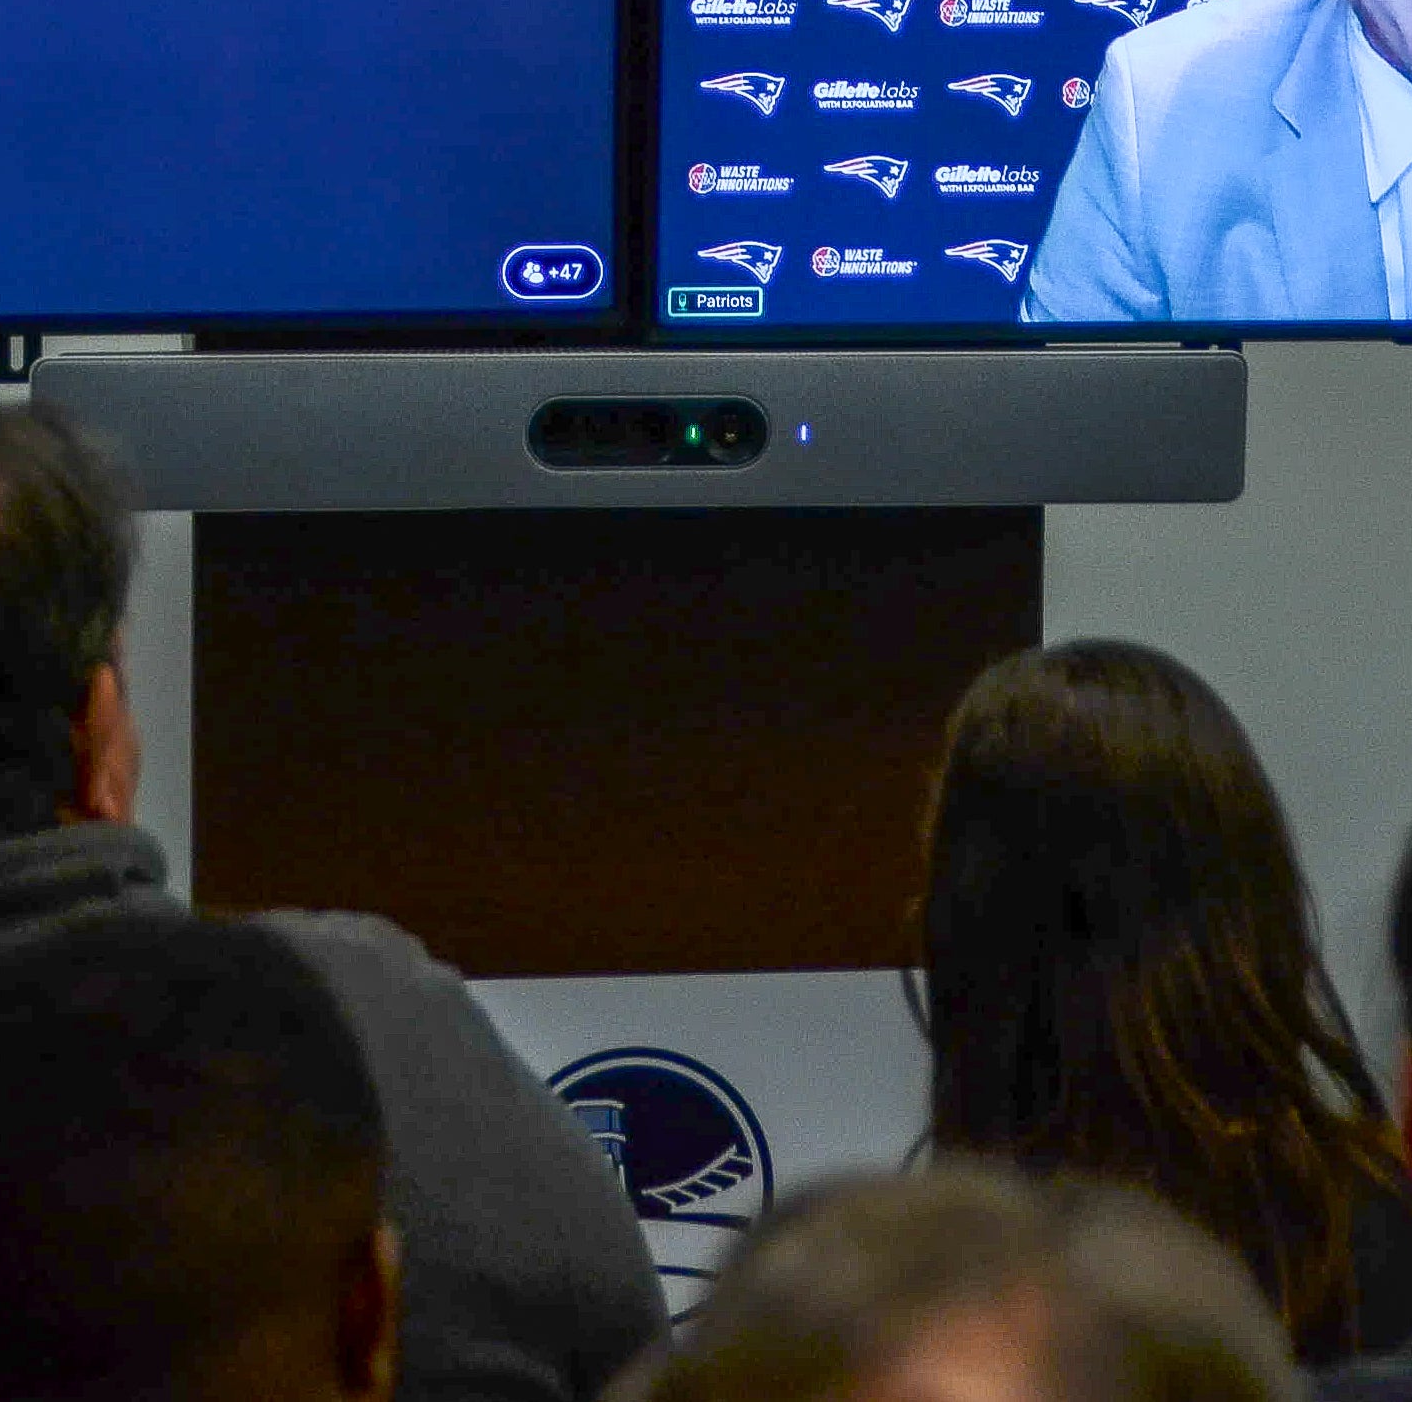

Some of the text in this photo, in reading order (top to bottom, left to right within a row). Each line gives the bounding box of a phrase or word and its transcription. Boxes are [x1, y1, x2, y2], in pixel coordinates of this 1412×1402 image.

[967, 12, 1040, 24] INNOVATIONS
[720, 165, 760, 178] WASTE
[716, 179, 790, 192] INNOVATIONS
[843, 248, 883, 261] WASTE
[548, 263, 583, 281] +47
[839, 262, 913, 275] INNOVATIONS
[696, 294, 754, 309] Patriots
